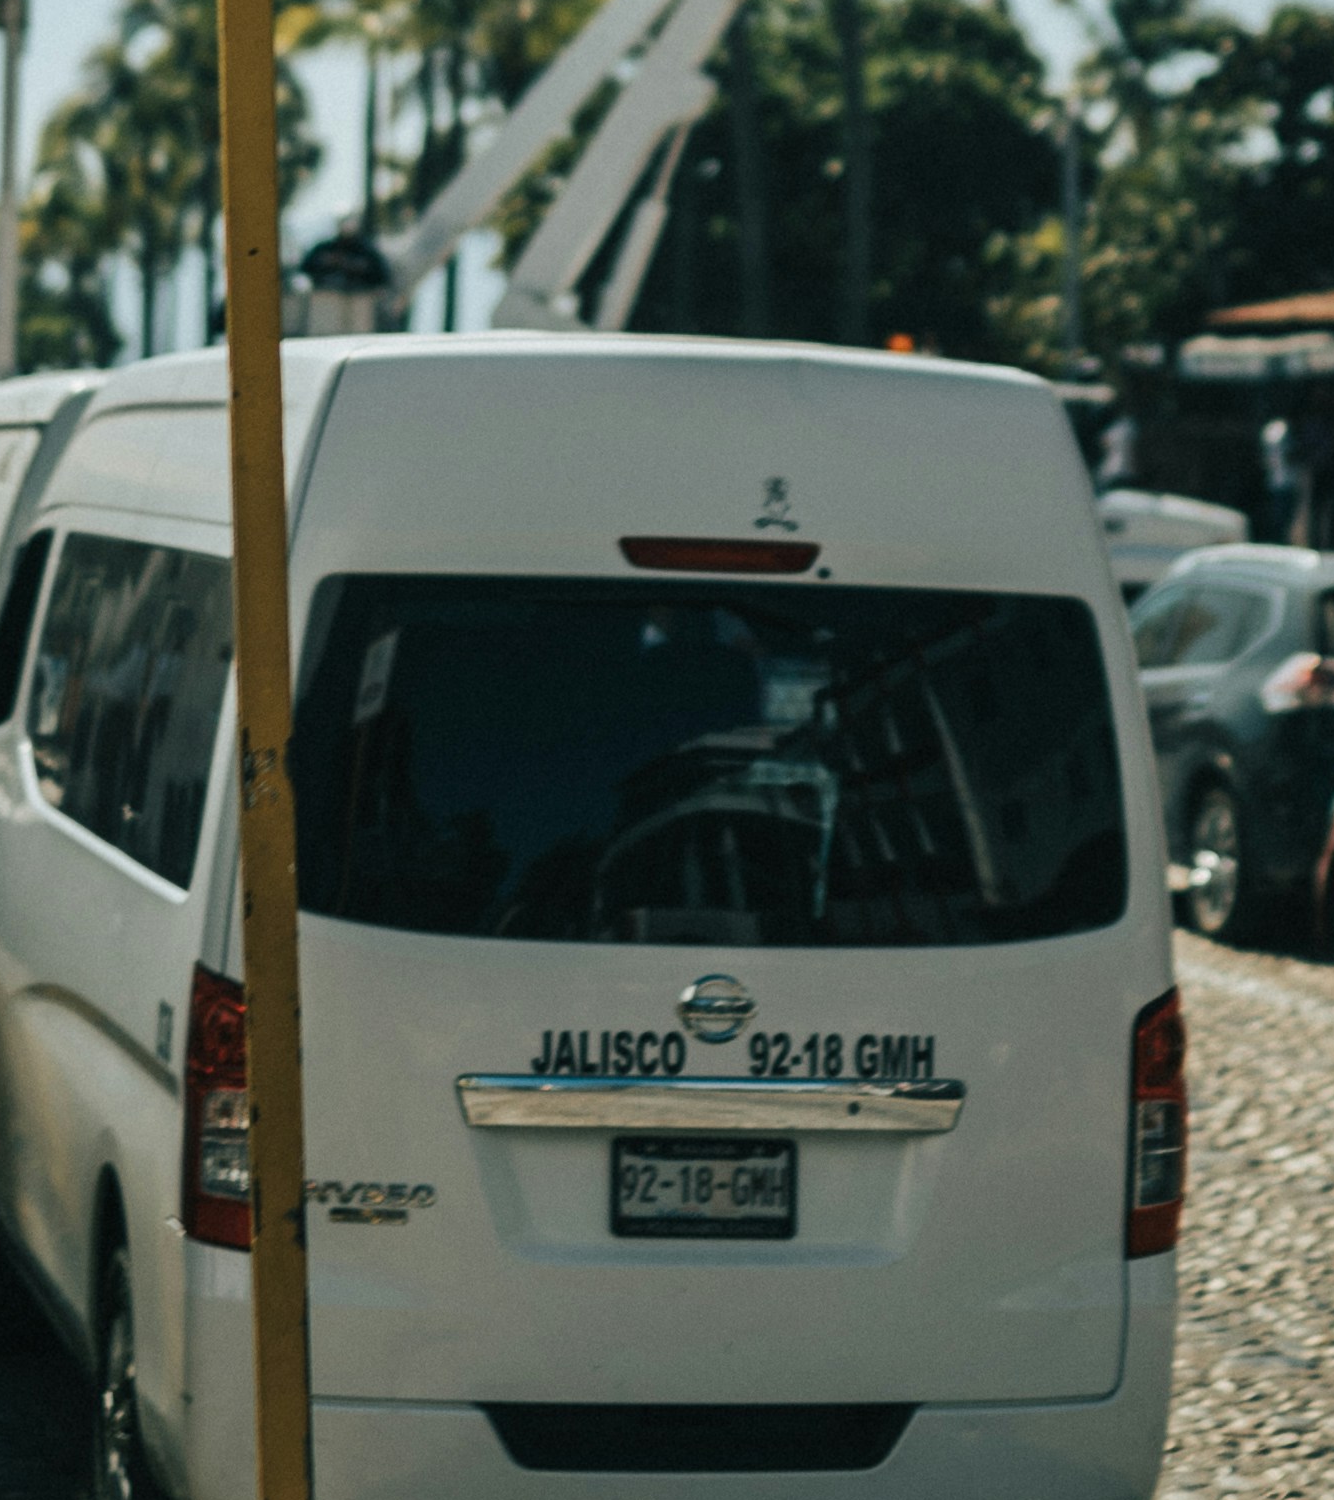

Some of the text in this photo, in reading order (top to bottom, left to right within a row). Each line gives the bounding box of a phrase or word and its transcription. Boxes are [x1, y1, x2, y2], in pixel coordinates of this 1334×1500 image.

[529, 1030, 935, 1079] JALISCO 92-18 GMH
[621, 1165, 788, 1207] 92-18-GMH
